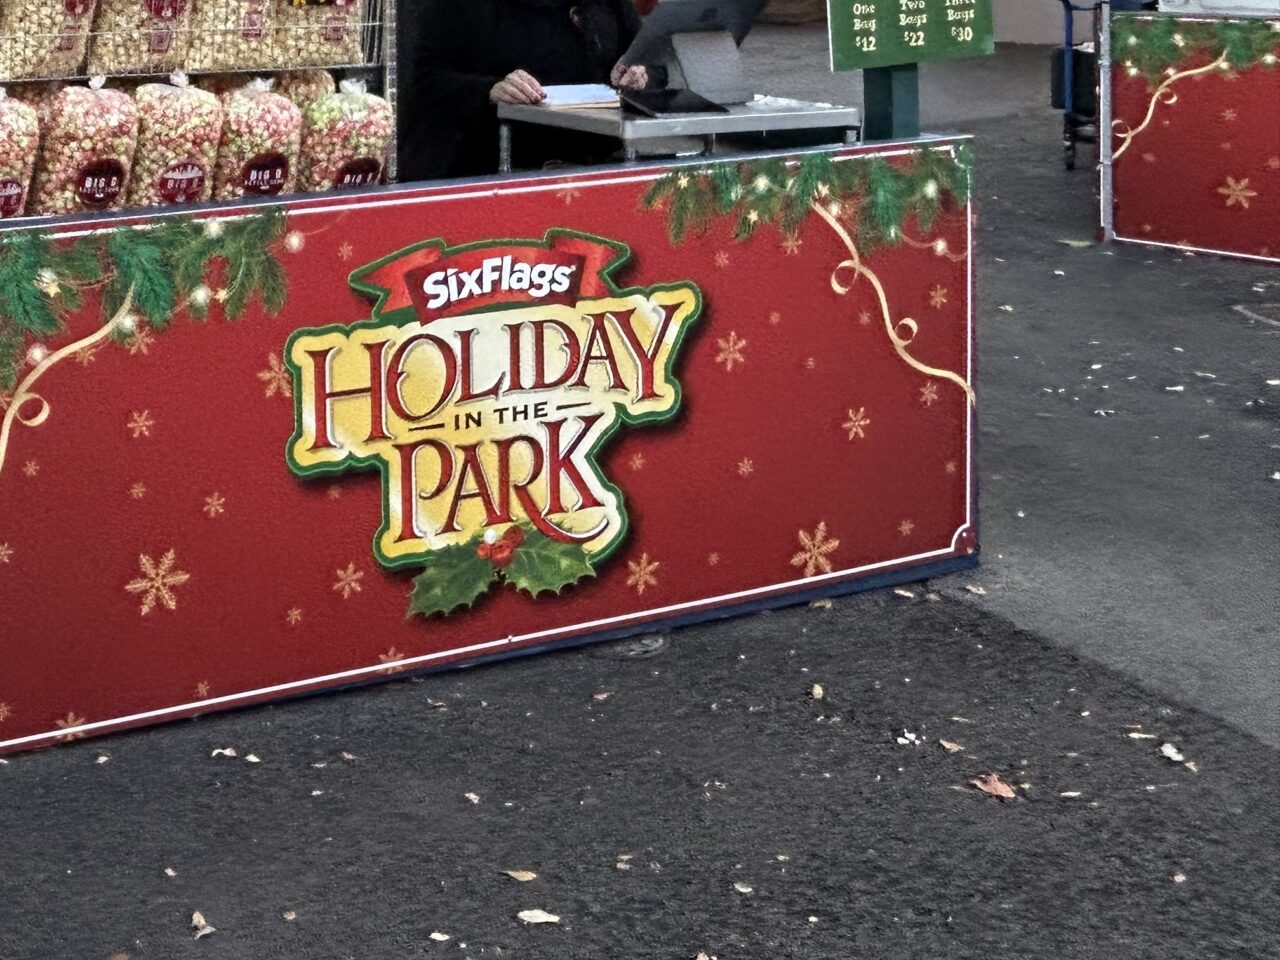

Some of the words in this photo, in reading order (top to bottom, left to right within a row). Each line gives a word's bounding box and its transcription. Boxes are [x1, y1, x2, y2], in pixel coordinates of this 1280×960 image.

[853, 4, 875, 15] One
[947, 9, 974, 21] Bags
[854, 18, 876, 31] Bag
[900, 13, 927, 27] Bags
[904, 32, 924, 46] $22
[952, 27, 973, 41] $30
[856, 36, 876, 51] $12
[304, 302, 688, 452] HOLIDAY
[454, 414, 483, 430] IN
[493, 401, 548, 425] THE
[392, 414, 609, 544] PARK
